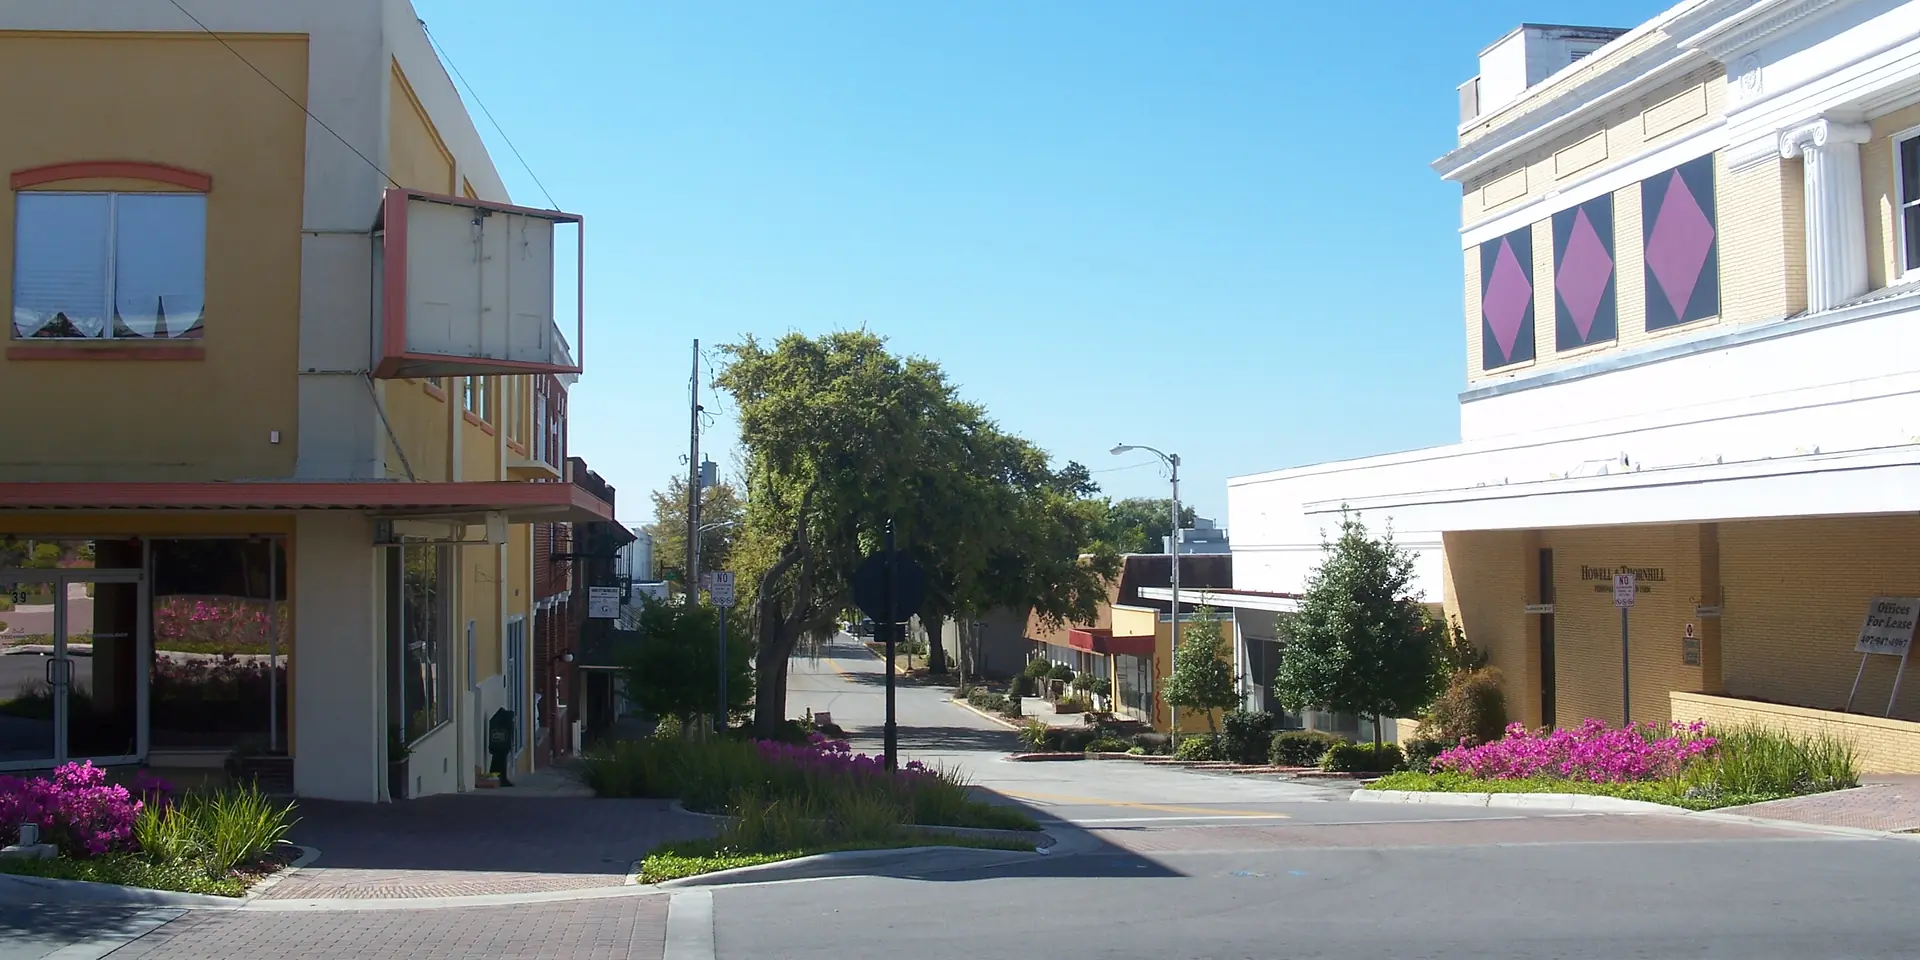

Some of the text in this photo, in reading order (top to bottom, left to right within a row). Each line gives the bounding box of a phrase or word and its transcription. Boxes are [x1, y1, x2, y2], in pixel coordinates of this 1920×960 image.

[717, 573, 728, 583] NO
[1619, 576, 1628, 585] NO
[11, 591, 27, 604] 39
[1878, 602, 1911, 615] Offices
[1867, 615, 1912, 629] For Lease
